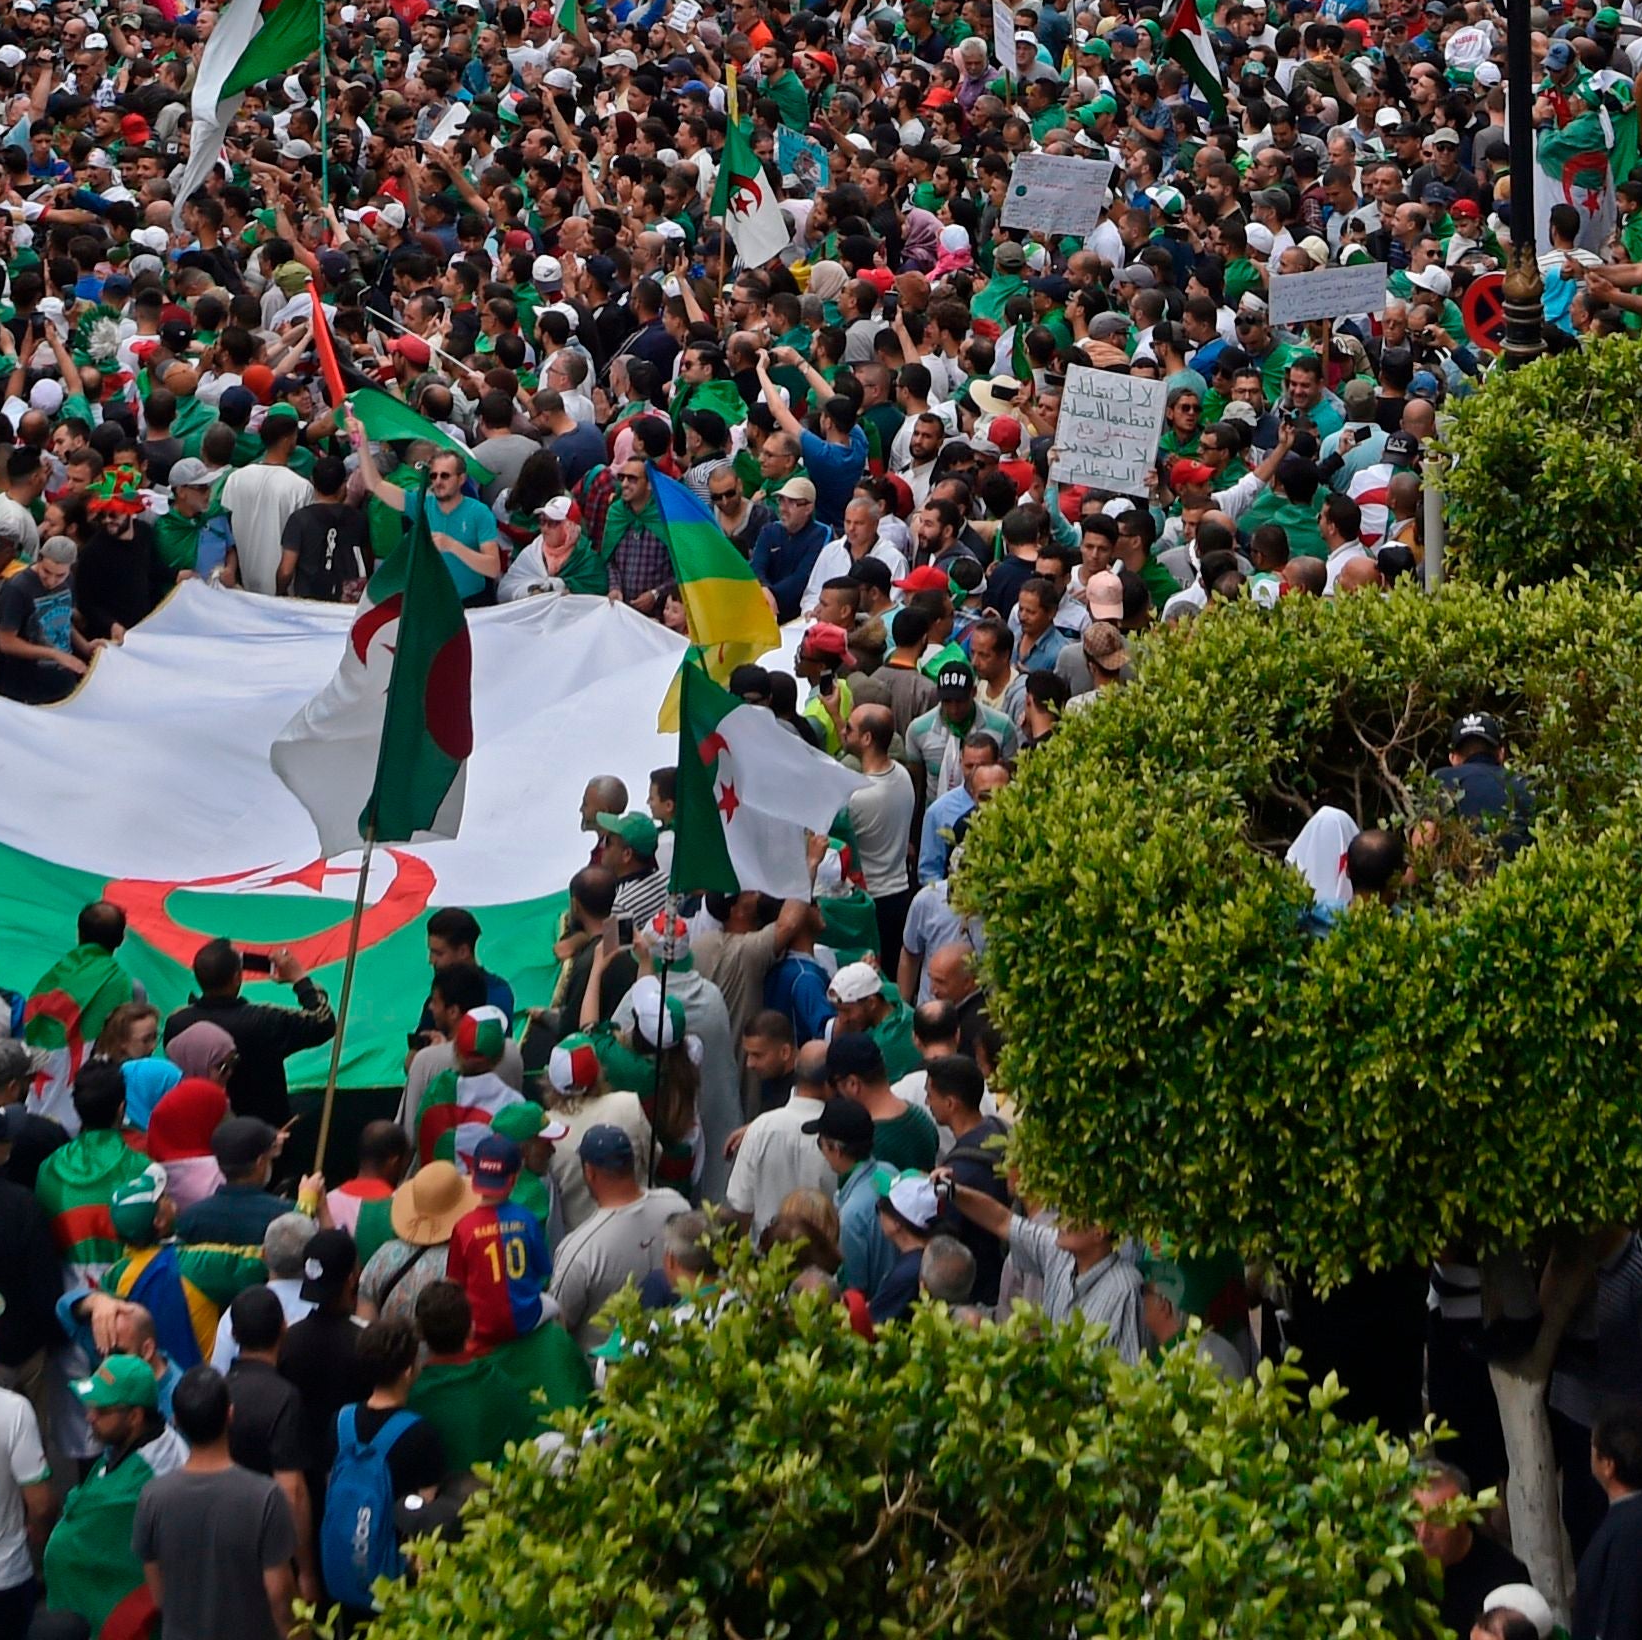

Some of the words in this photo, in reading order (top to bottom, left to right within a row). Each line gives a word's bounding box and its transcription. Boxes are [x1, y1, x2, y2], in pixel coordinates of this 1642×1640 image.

[1137, 384, 1153, 408] لا
[1387, 437, 1408, 449] EA7
[1132, 447, 1148, 465] لا
[1069, 458, 1136, 482] النظام
[939, 672, 967, 687] ICON
[483, 1236, 527, 1283] 10
